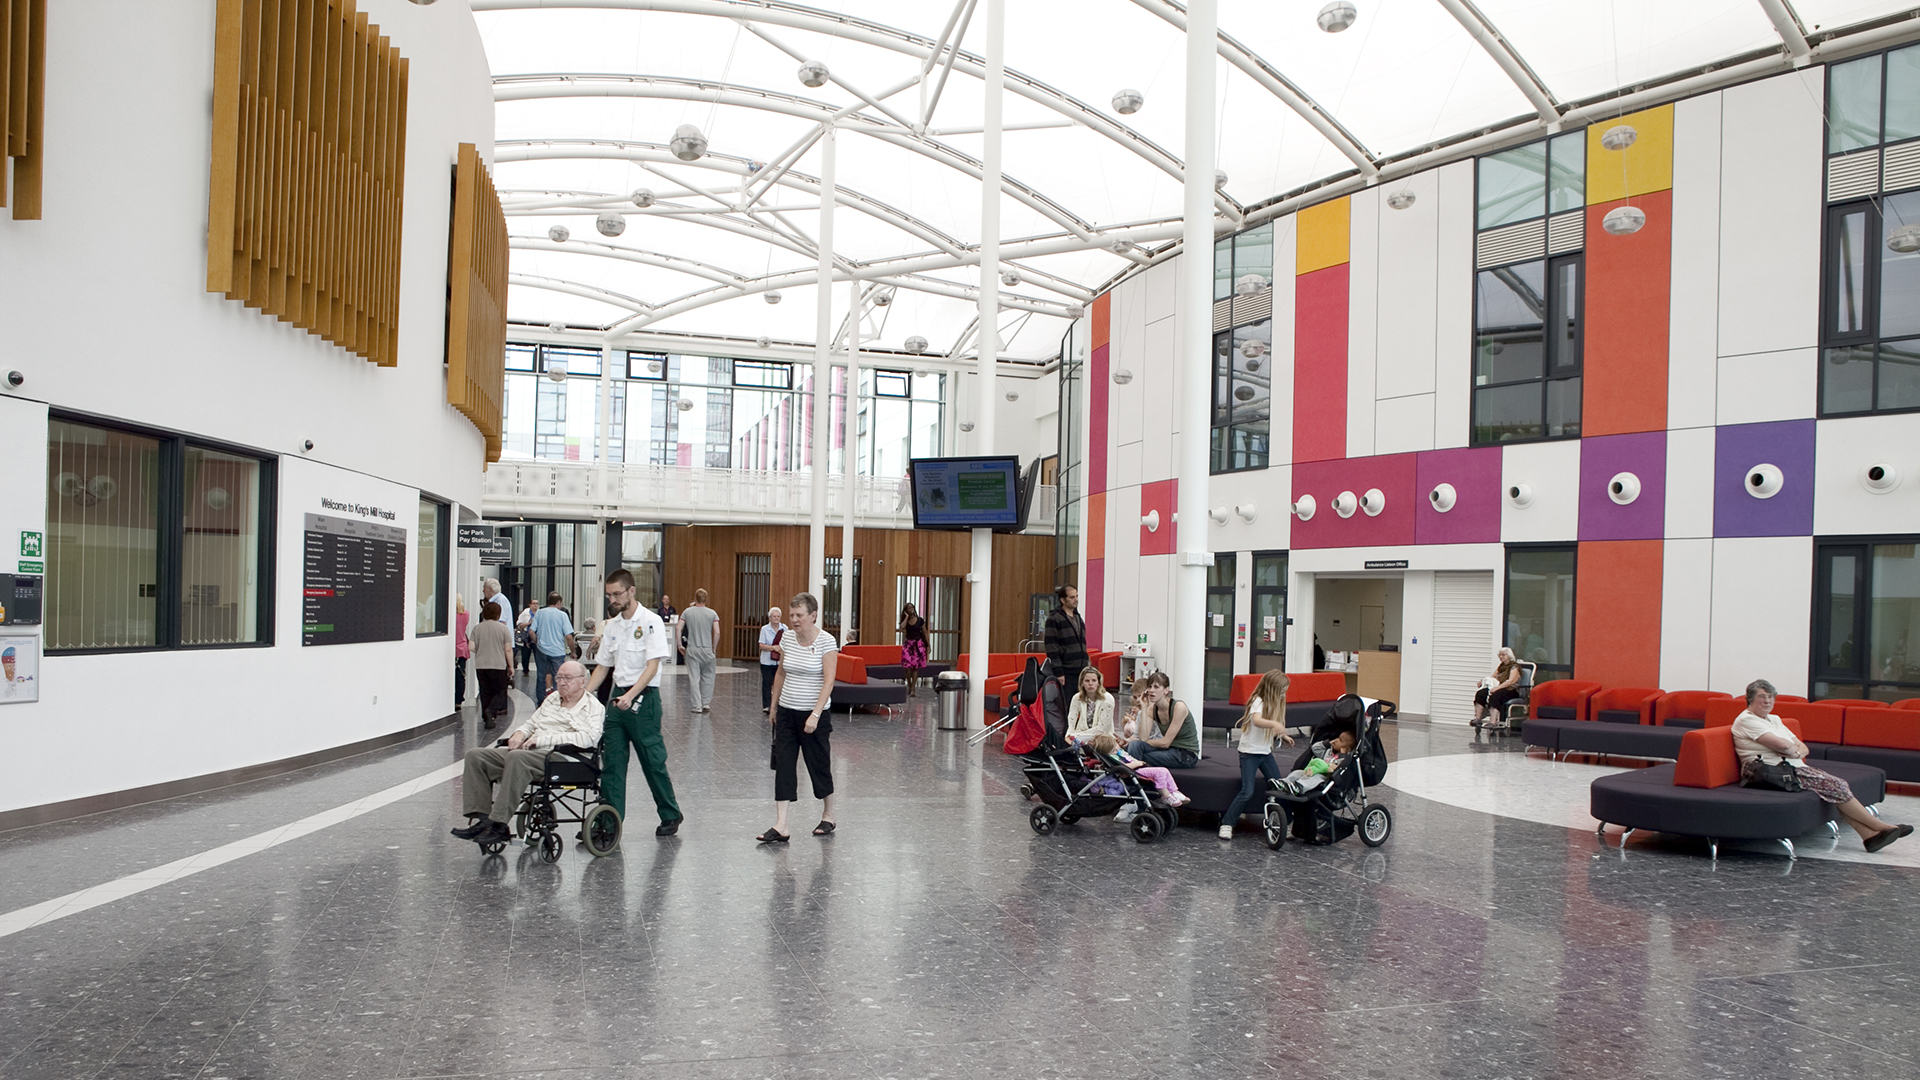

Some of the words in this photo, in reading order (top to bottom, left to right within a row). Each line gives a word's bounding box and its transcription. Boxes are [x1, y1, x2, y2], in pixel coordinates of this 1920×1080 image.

[321, 498, 347, 512] Welcome
[348, 503, 354, 512] to
[355, 504, 369, 517] King's
[379, 508, 395, 520] Hospital
